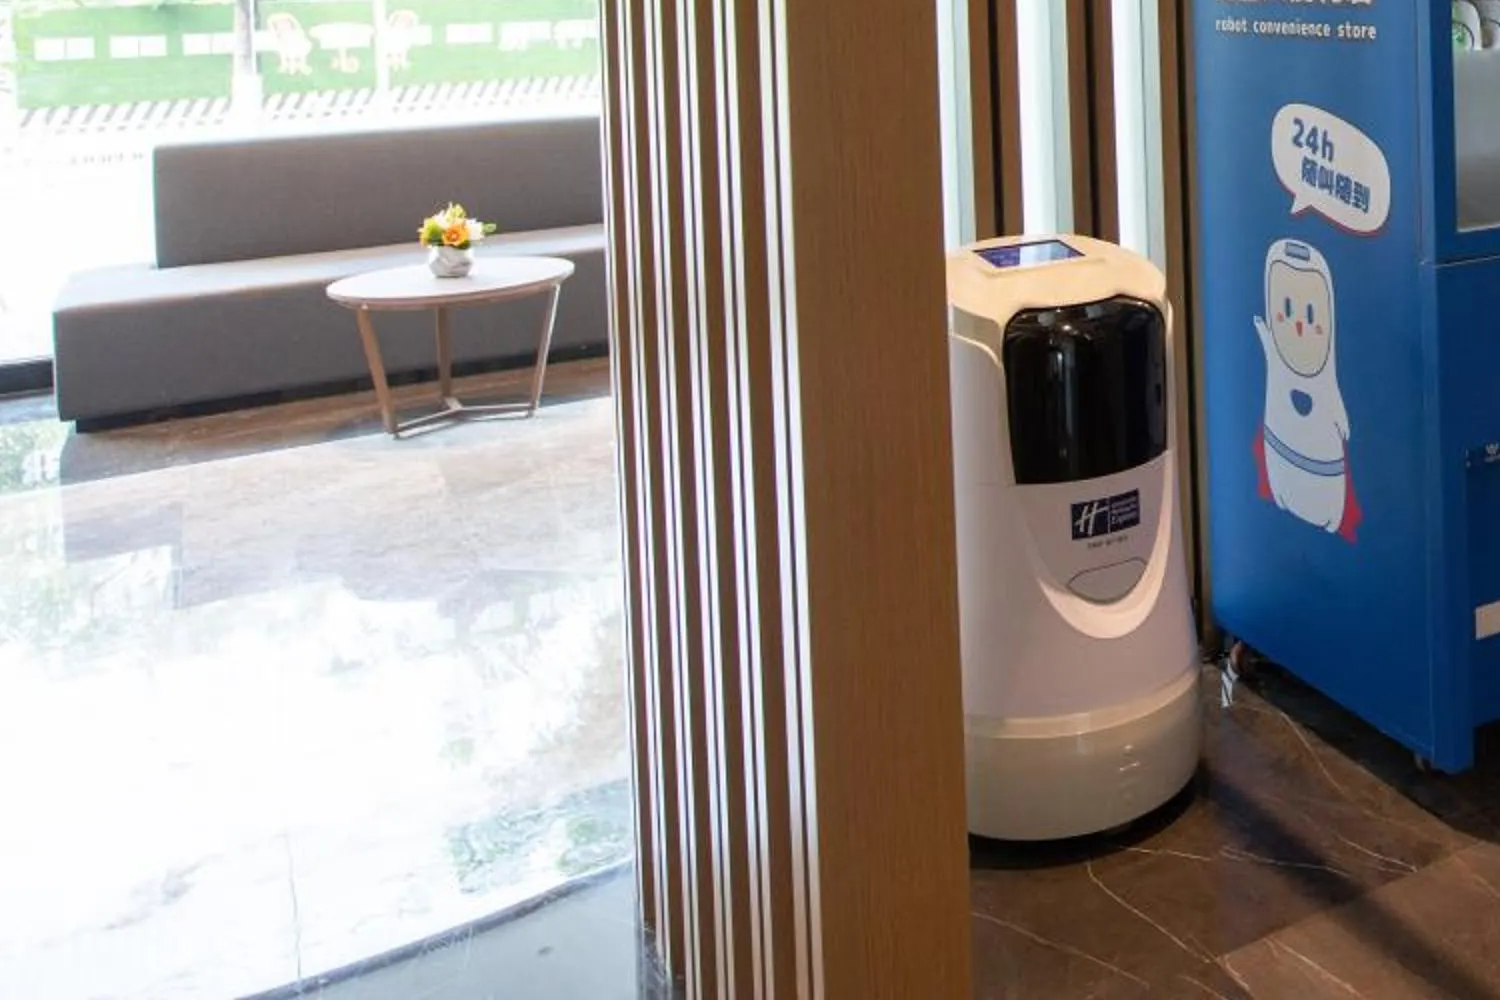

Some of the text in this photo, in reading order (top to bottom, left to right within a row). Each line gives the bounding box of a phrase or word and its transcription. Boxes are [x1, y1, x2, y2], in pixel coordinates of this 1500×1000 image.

[1215, 16, 1377, 40] robot convenience store
[1292, 116, 1334, 163] 24h
[1301, 155, 1371, 214] 随叫随到
